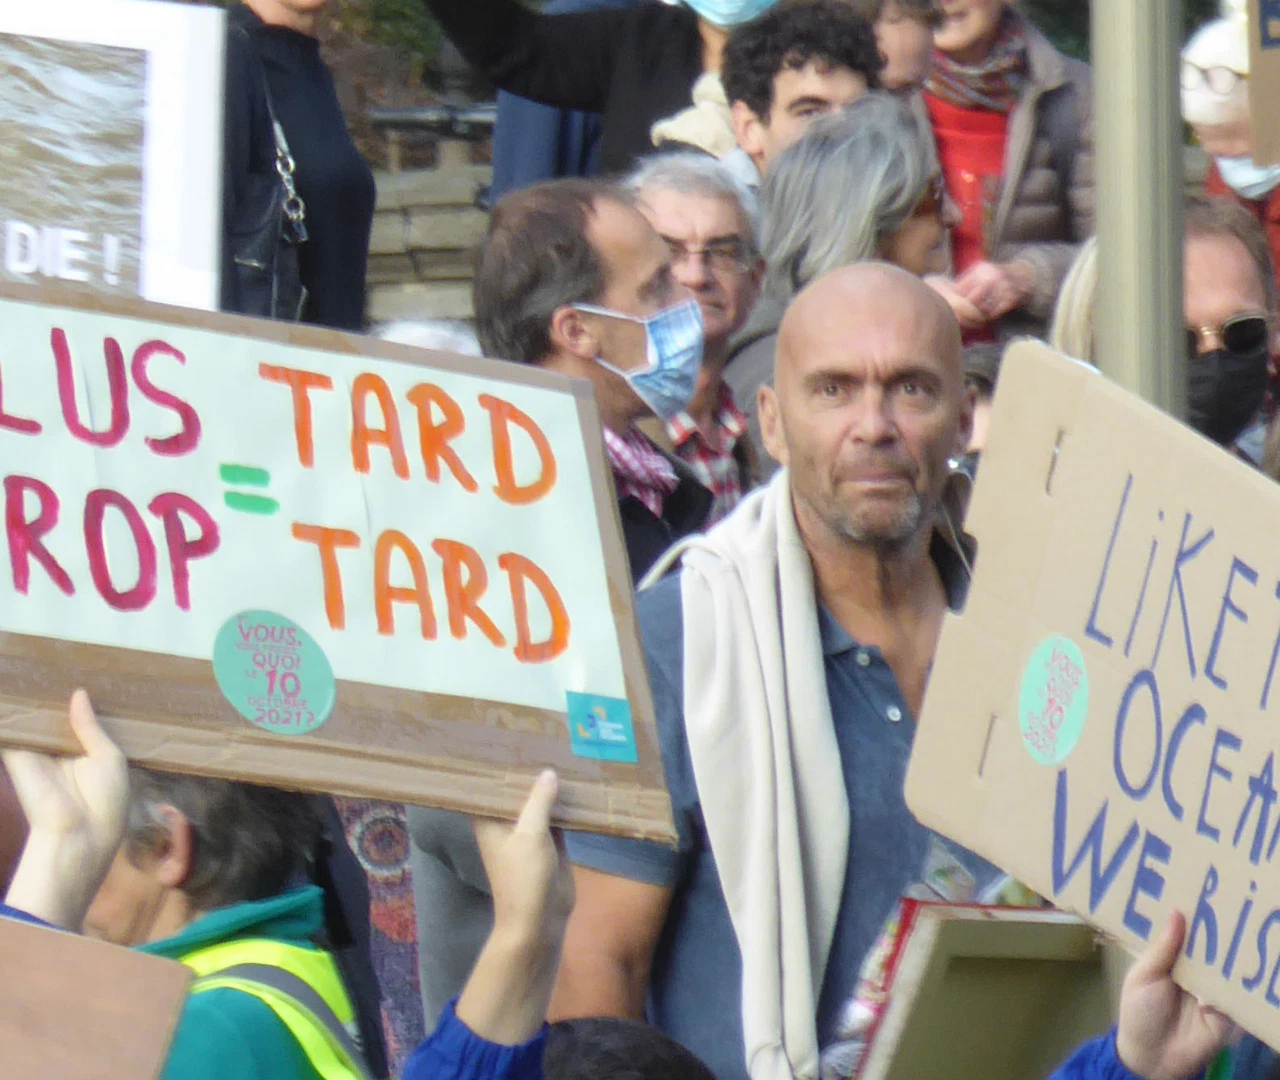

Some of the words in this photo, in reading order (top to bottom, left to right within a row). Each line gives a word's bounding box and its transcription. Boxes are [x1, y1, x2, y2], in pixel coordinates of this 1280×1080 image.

[259, 362, 557, 505] TARD
[3, 475, 221, 613] ROP
[291, 521, 571, 664] TARD
[265, 670, 301, 699] 10
[1050, 768, 1175, 940] WE
